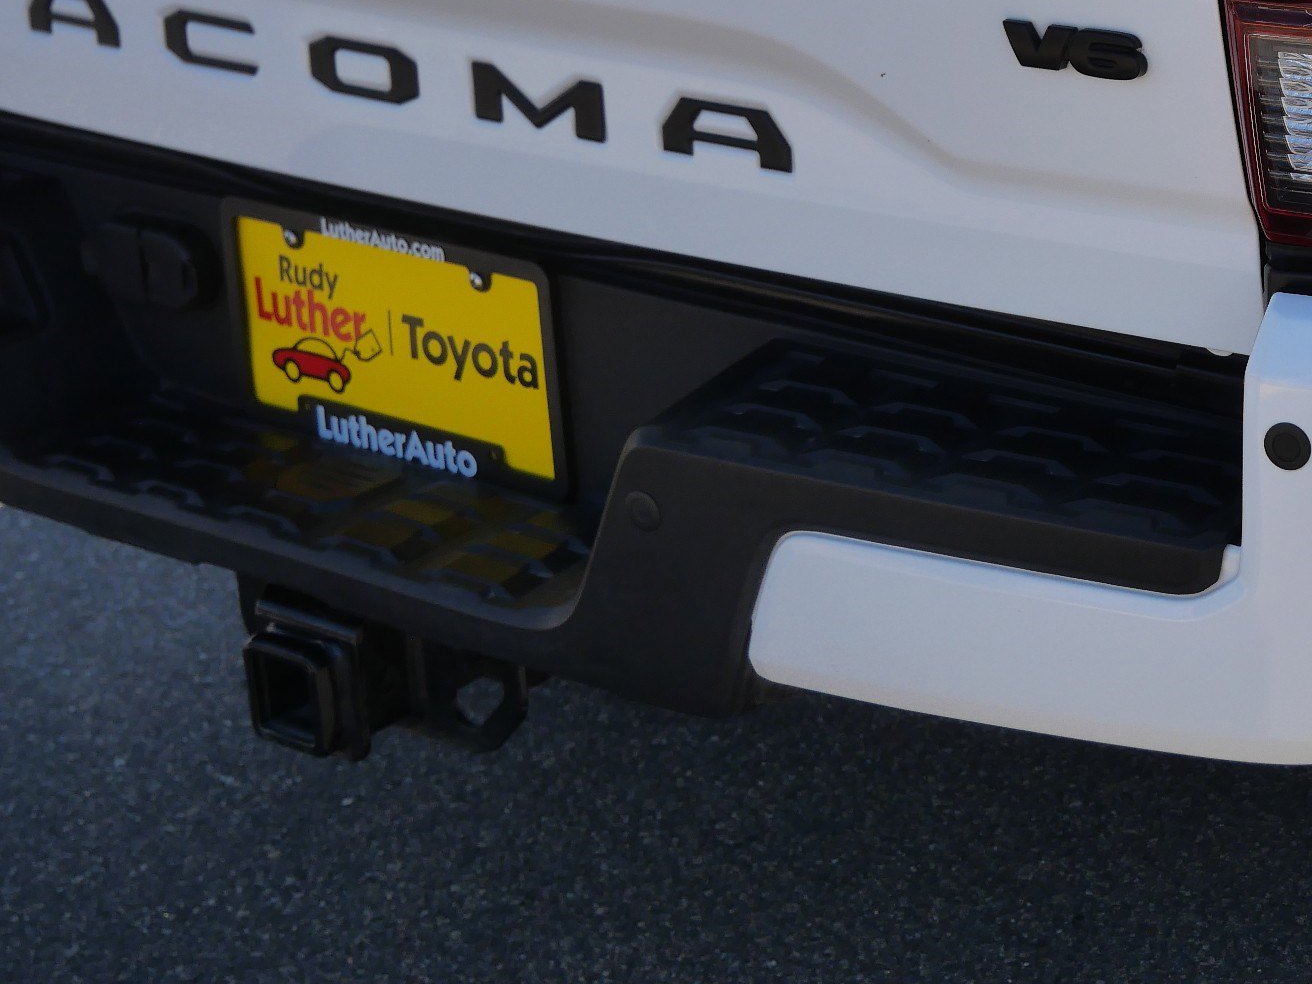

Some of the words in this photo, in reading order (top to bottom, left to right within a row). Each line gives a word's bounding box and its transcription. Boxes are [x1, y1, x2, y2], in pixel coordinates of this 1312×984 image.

[1002, 18, 1149, 81] V6
[319, 217, 445, 262] LutherAuto.com
[254, 276, 366, 342] Luther
[278, 255, 339, 300] Rudy
[401, 313, 540, 390] Toyota
[315, 404, 478, 479] LutherAuto
